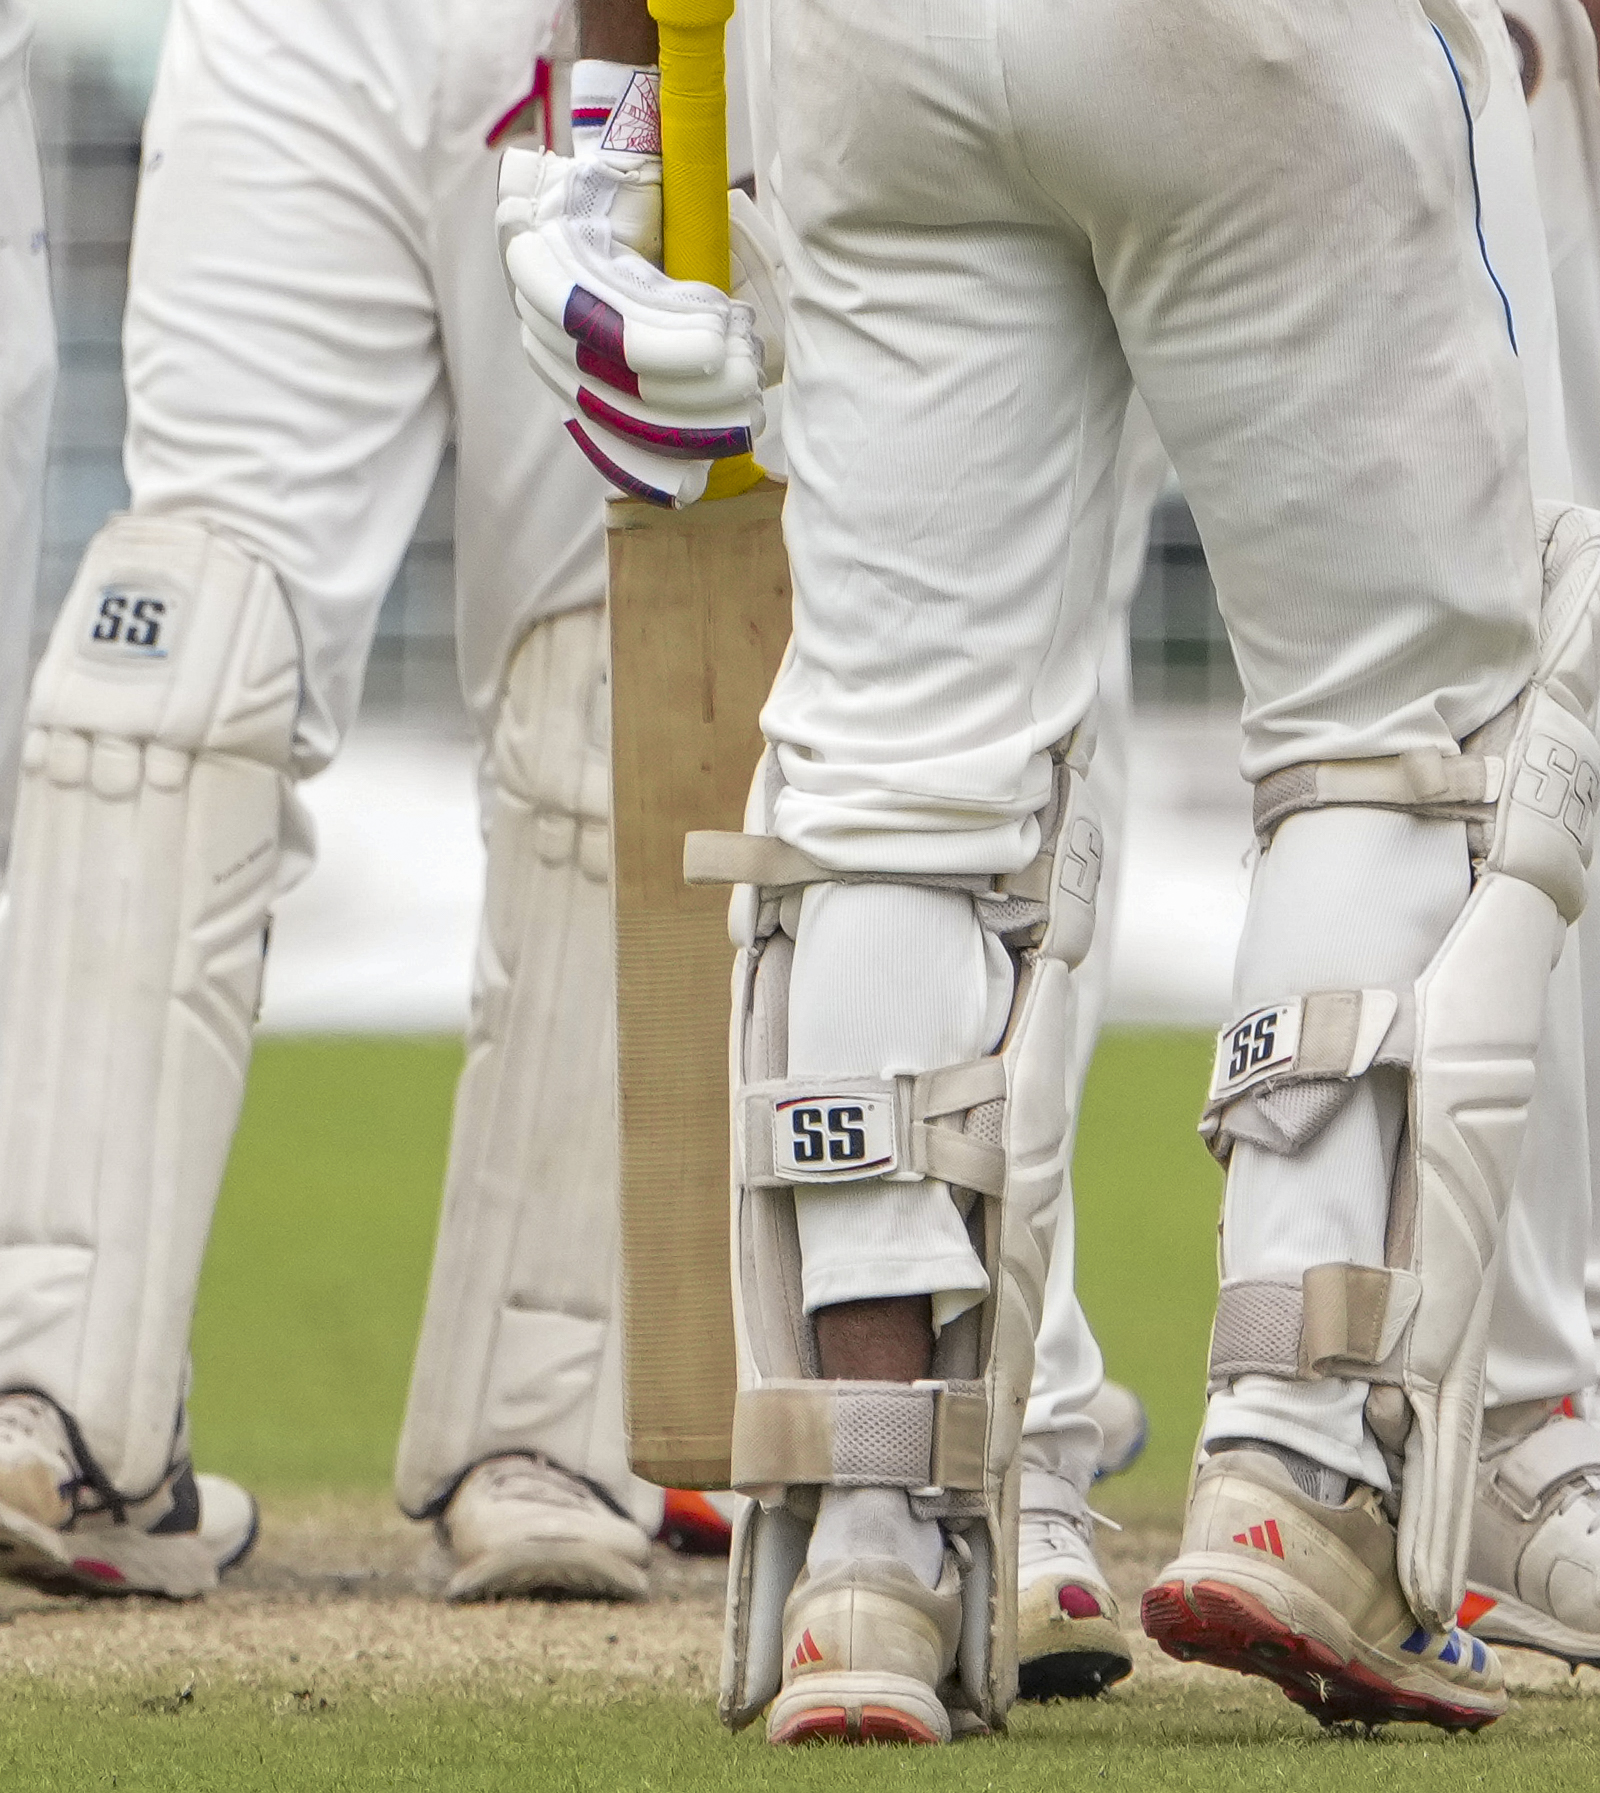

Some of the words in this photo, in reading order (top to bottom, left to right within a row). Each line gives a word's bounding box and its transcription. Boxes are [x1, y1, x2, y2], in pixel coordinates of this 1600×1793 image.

[92, 595, 166, 647] SS
[1229, 1011, 1278, 1081] SS
[792, 1106, 866, 1162] SS
